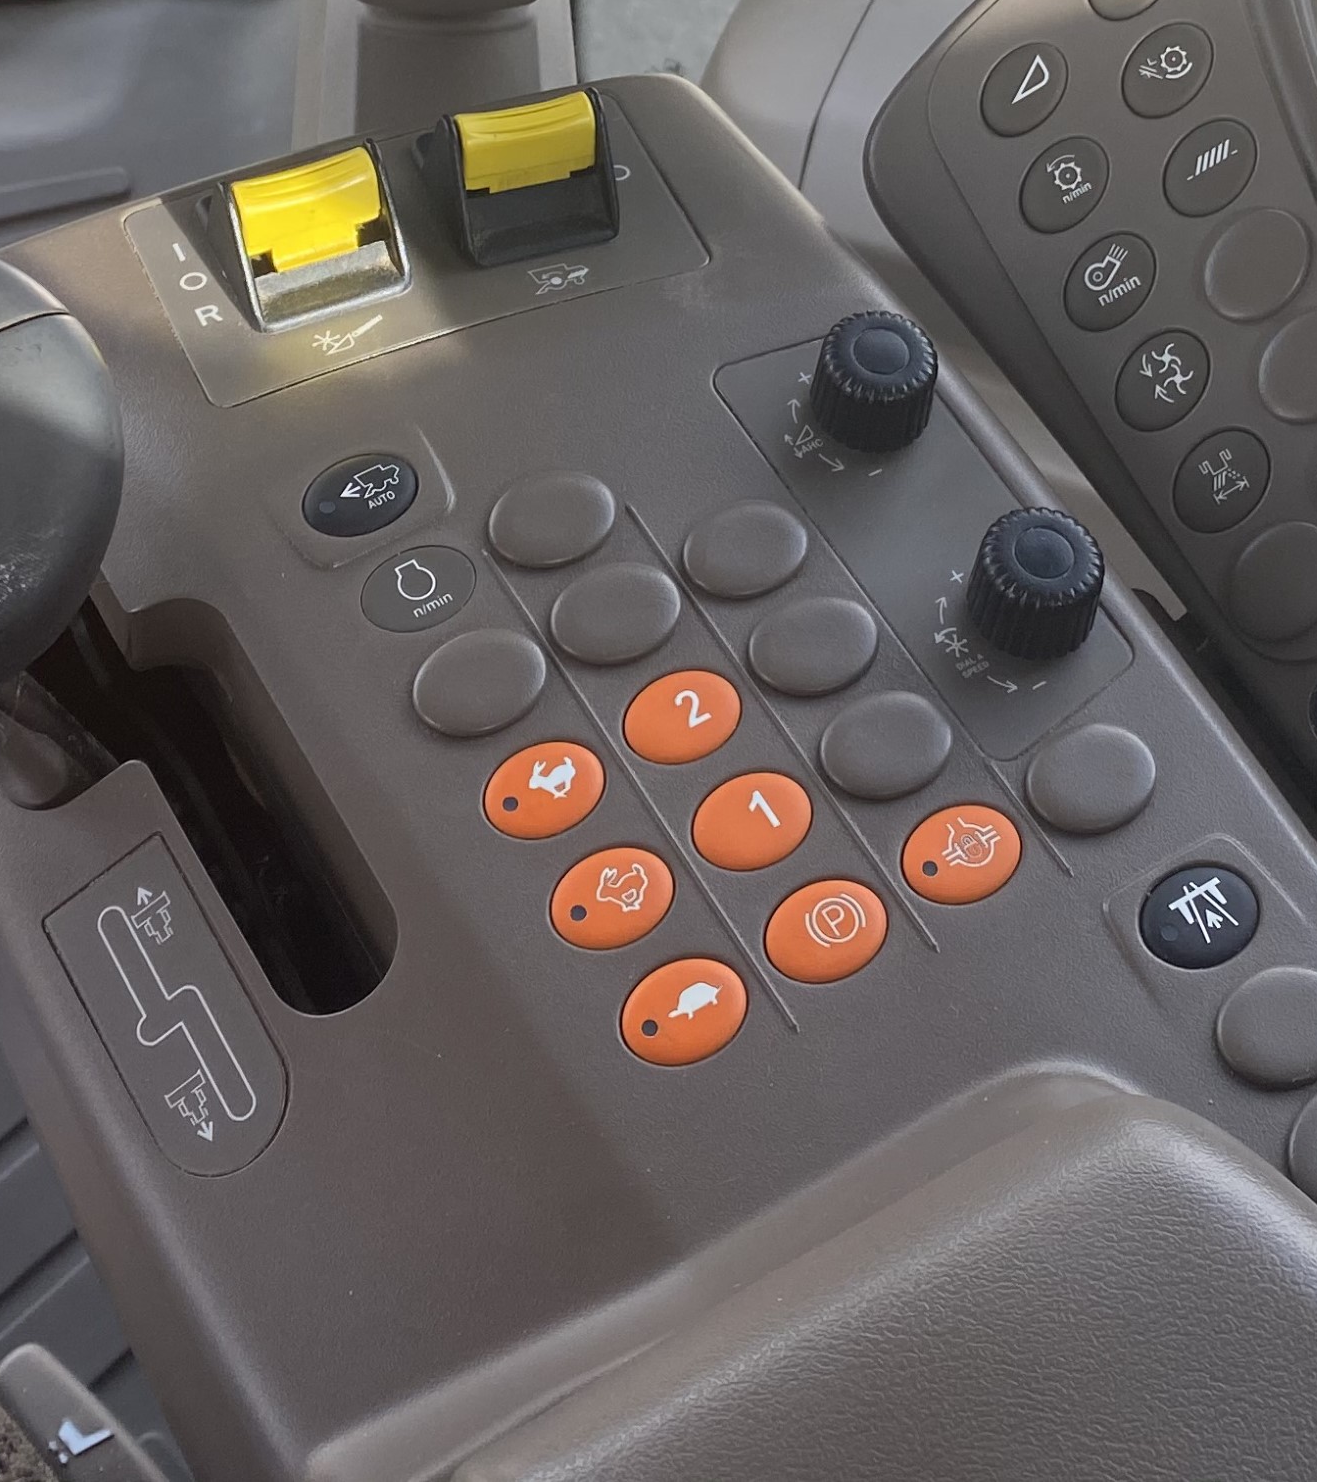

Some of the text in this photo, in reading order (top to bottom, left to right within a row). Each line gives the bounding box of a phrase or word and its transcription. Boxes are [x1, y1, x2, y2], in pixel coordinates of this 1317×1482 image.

[1062, 181, 1093, 205] n/min
[1098, 274, 1142, 306] n/min
[194, 304, 223, 327] R
[367, 490, 396, 509] AUTO
[413, 592, 454, 619] n/min
[674, 689, 712, 728] 2
[748, 790, 781, 828] 1
